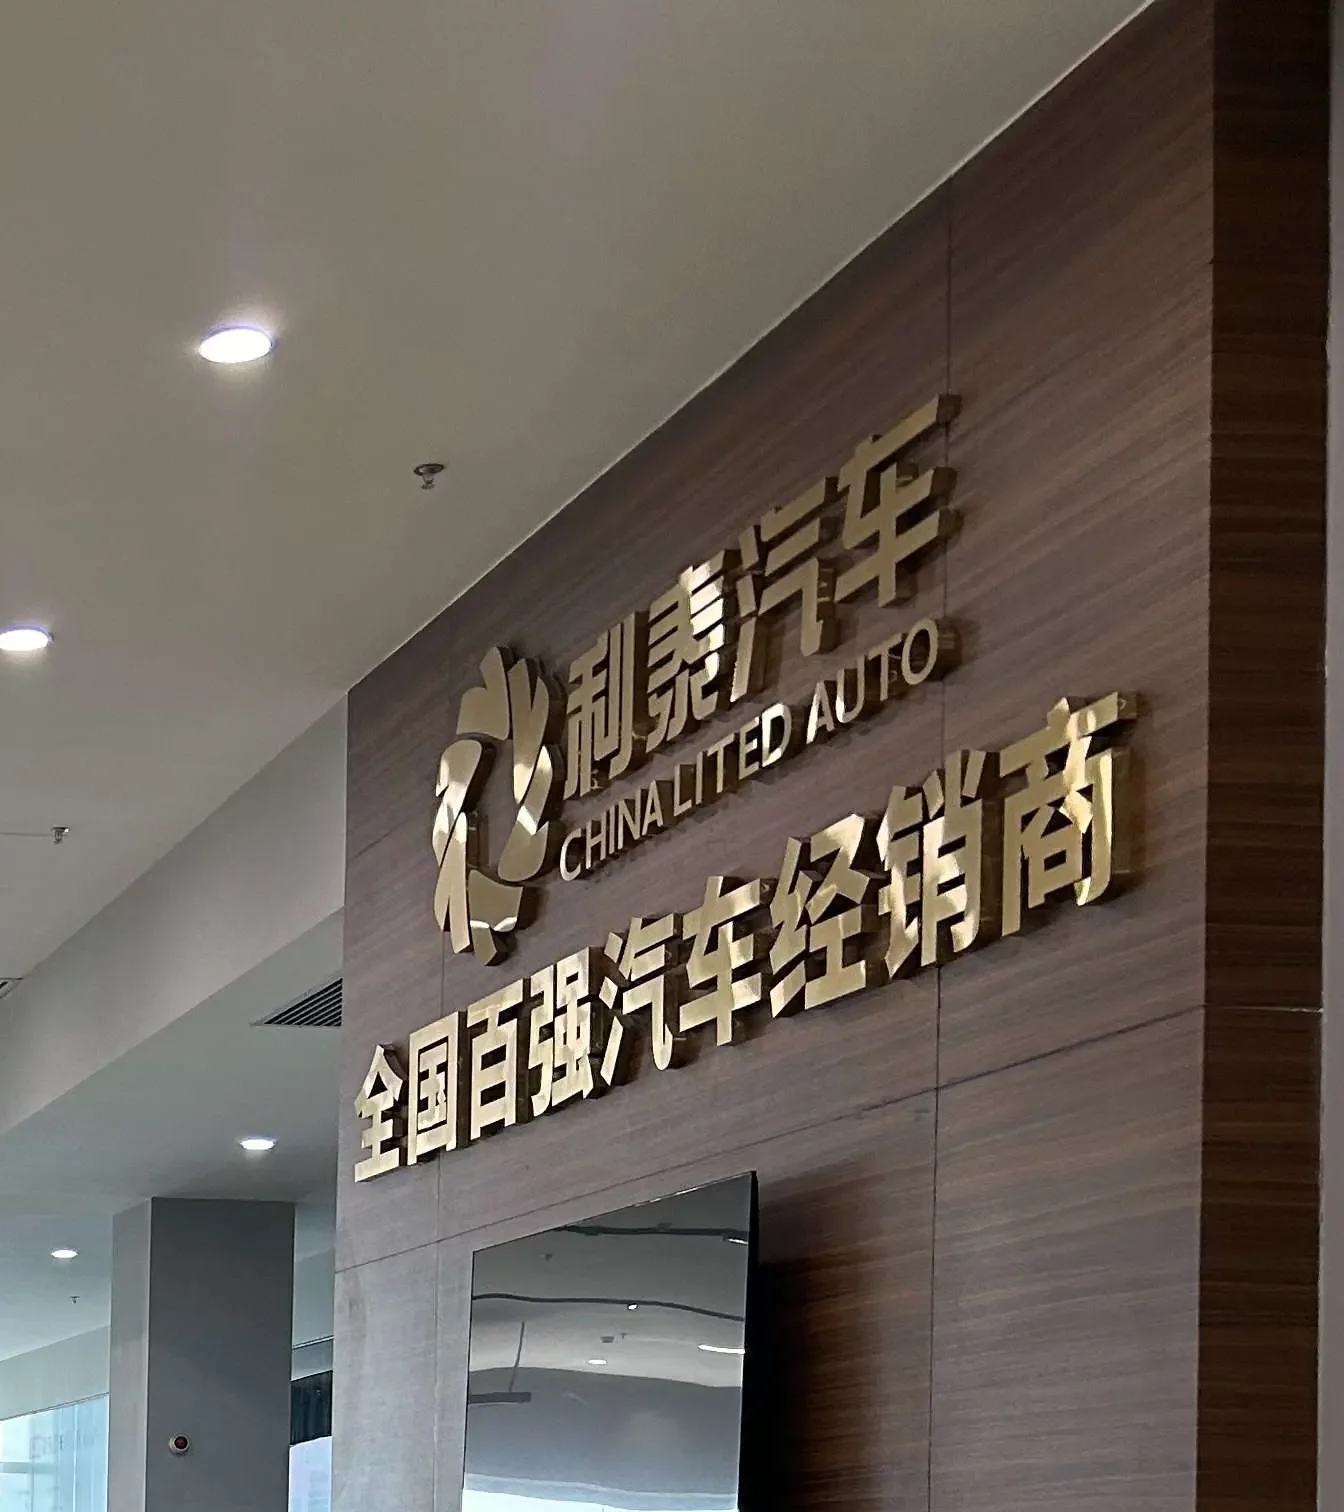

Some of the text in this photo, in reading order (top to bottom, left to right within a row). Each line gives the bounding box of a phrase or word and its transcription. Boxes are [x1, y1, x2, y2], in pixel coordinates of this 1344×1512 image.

[559, 617, 939, 881] CHINA LITED AUTO
[563, 394, 943, 800] 利泰汽车
[354, 692, 1119, 1183] 全国百强汽车经销商
